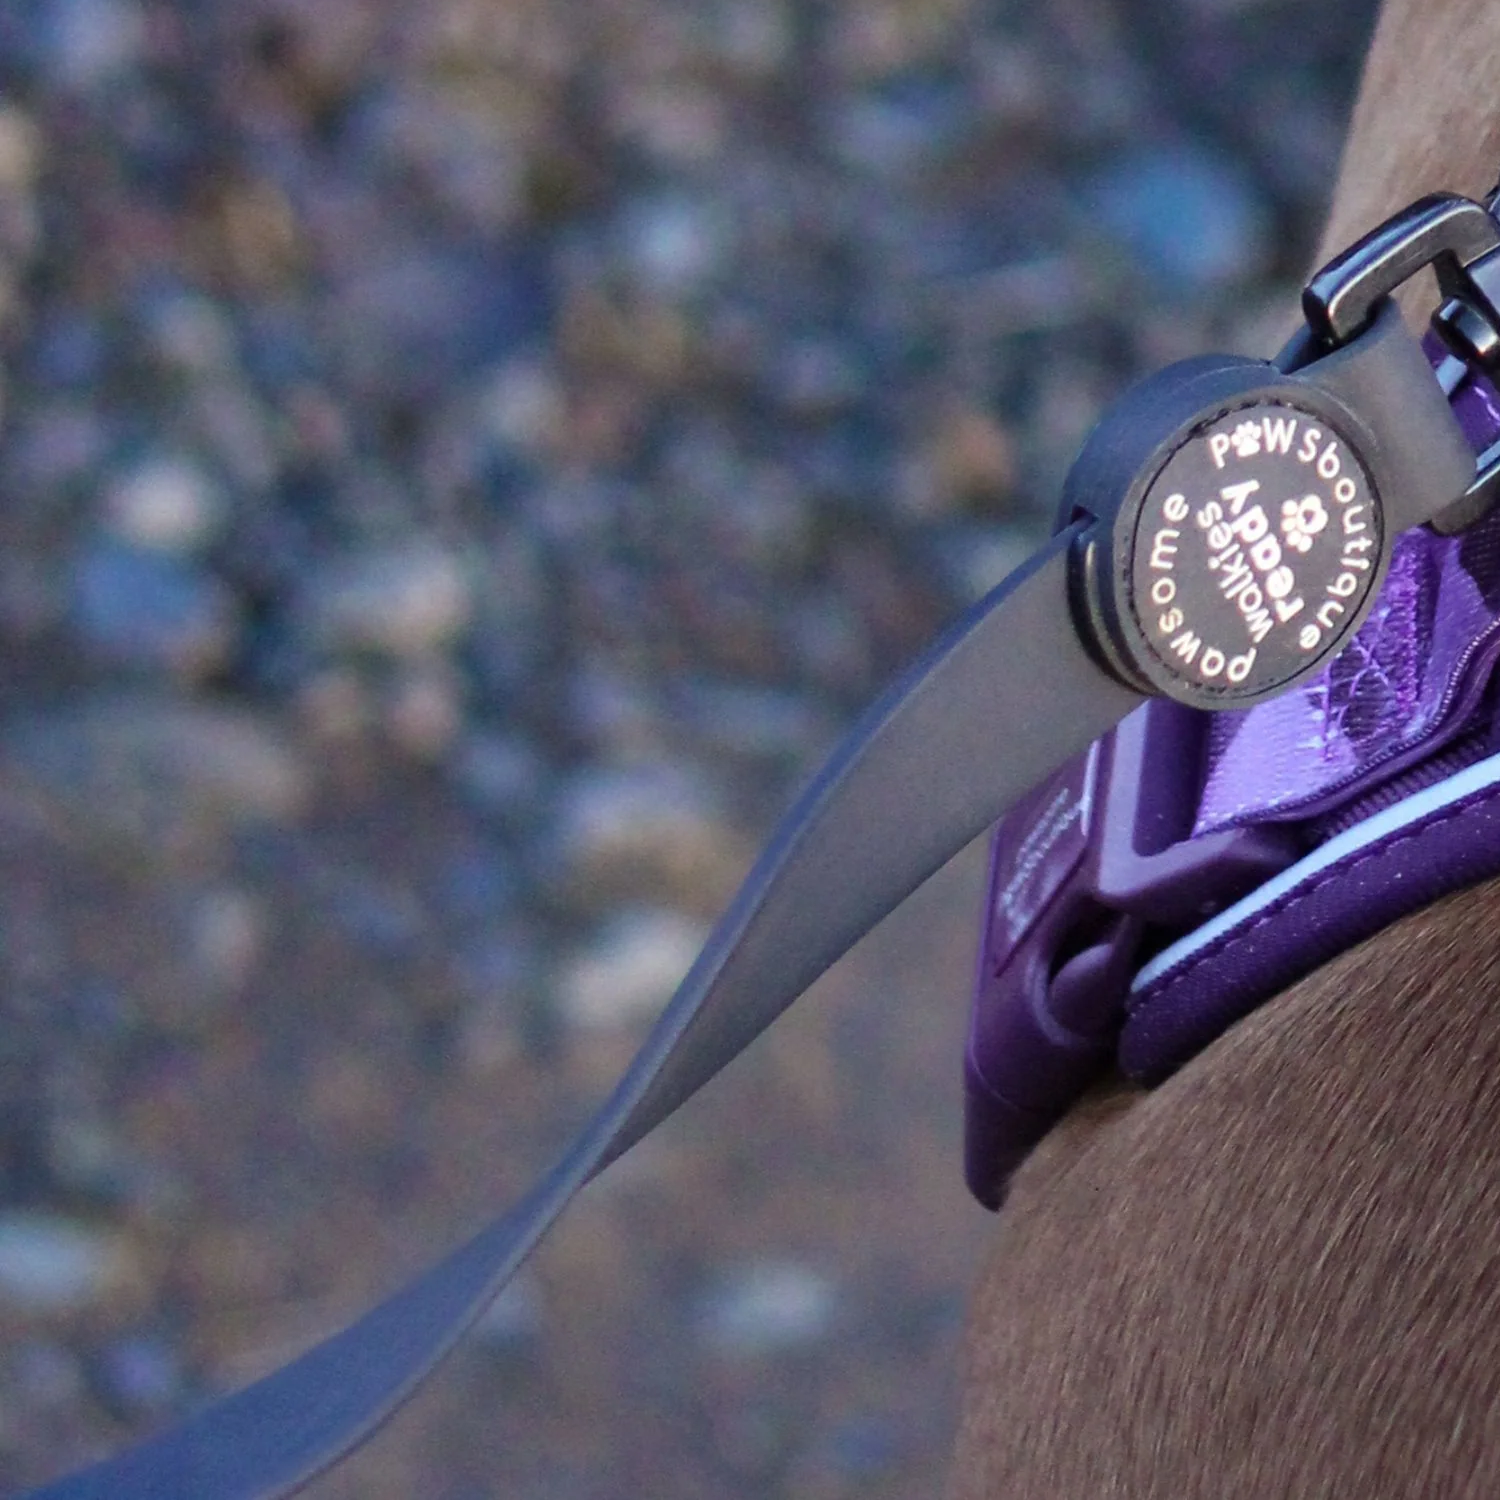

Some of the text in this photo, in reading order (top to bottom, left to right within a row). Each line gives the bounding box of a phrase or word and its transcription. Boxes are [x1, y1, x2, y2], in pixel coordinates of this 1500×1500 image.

[1150, 493, 1257, 682] pawsome
[1197, 501, 1275, 643] walkies
[1221, 479, 1304, 623] ready
